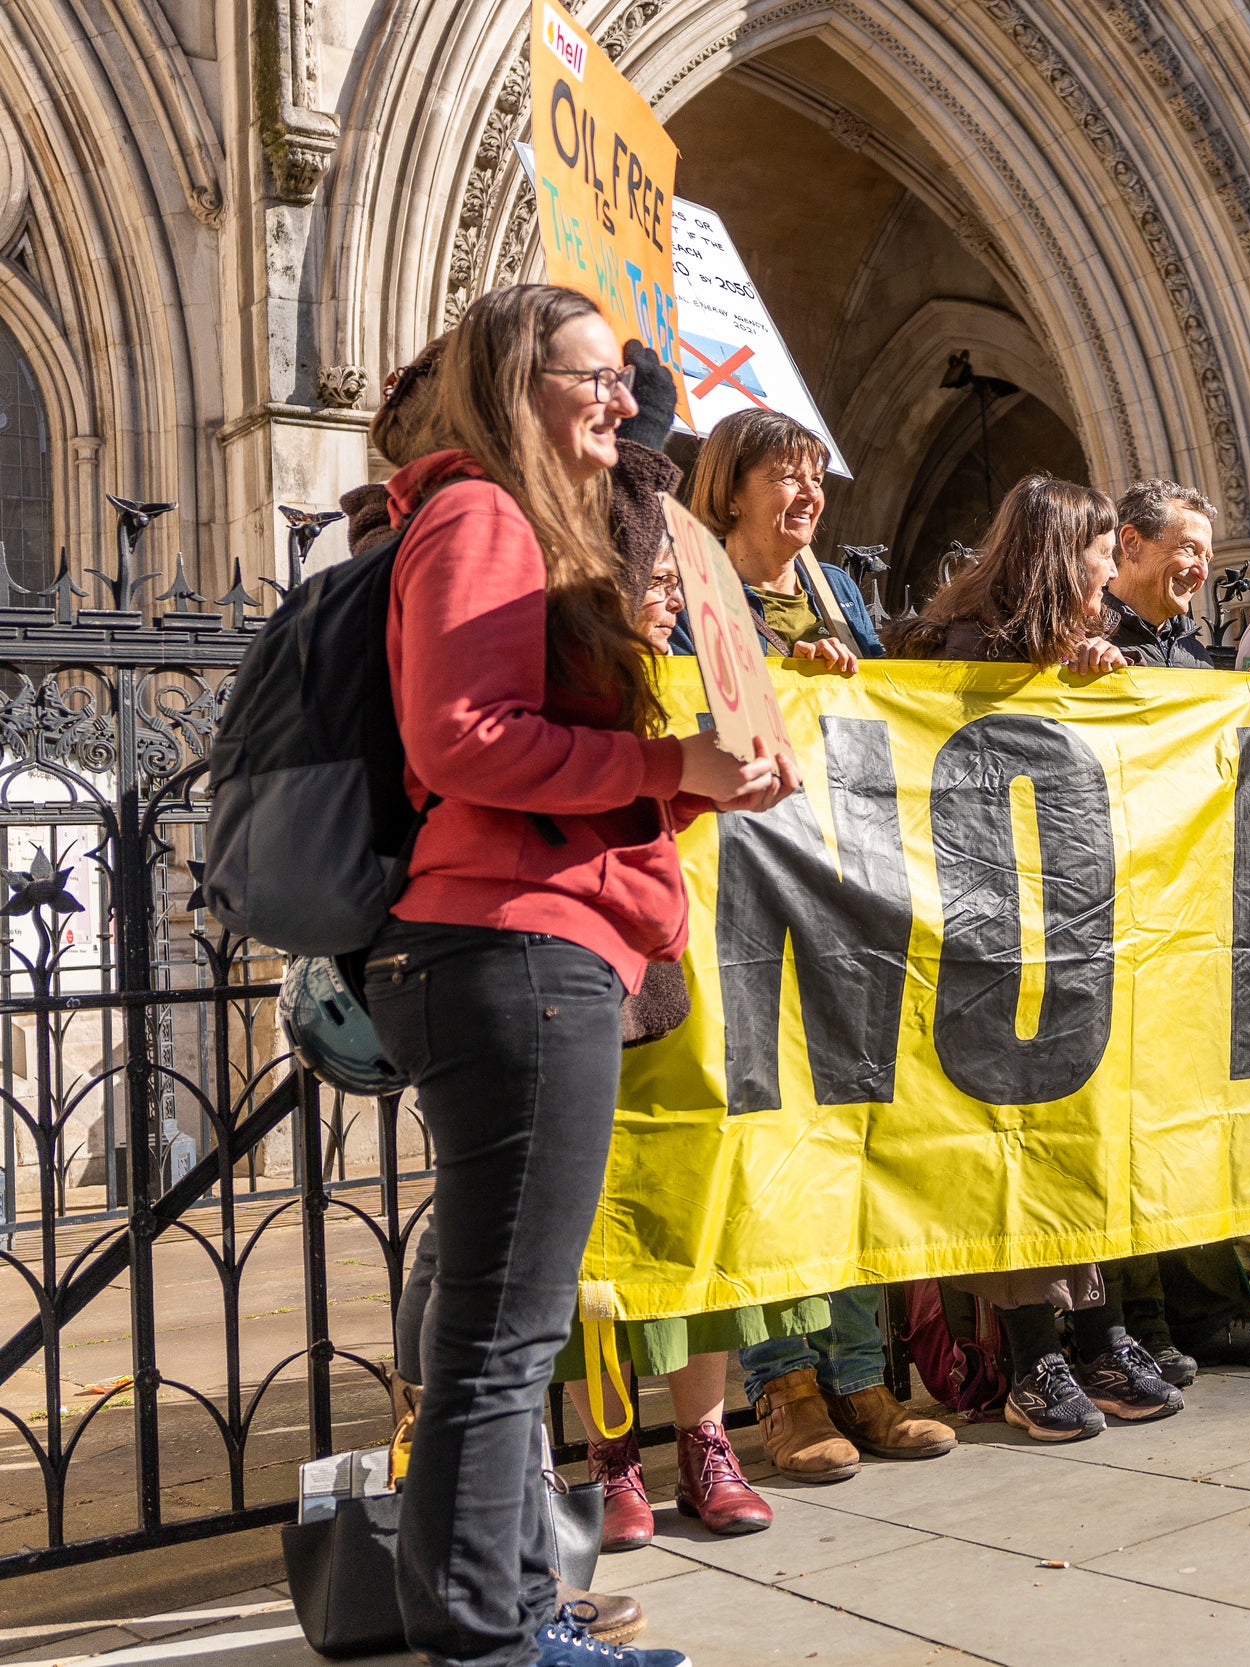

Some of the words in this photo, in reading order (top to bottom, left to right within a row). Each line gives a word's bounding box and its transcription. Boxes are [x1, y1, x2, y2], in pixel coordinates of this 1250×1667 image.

[556, 24, 583, 74] hell
[551, 78, 604, 194] OIL
[612, 132, 666, 253] FREE
[595, 191, 616, 236] IS
[694, 219, 714, 232] OR
[541, 176, 587, 271] THE
[585, 217, 628, 324] WAY
[700, 236, 725, 252] THE
[653, 281, 682, 373] BE
[693, 300, 728, 317] ENERGY
[697, 712, 1117, 1116] NO
